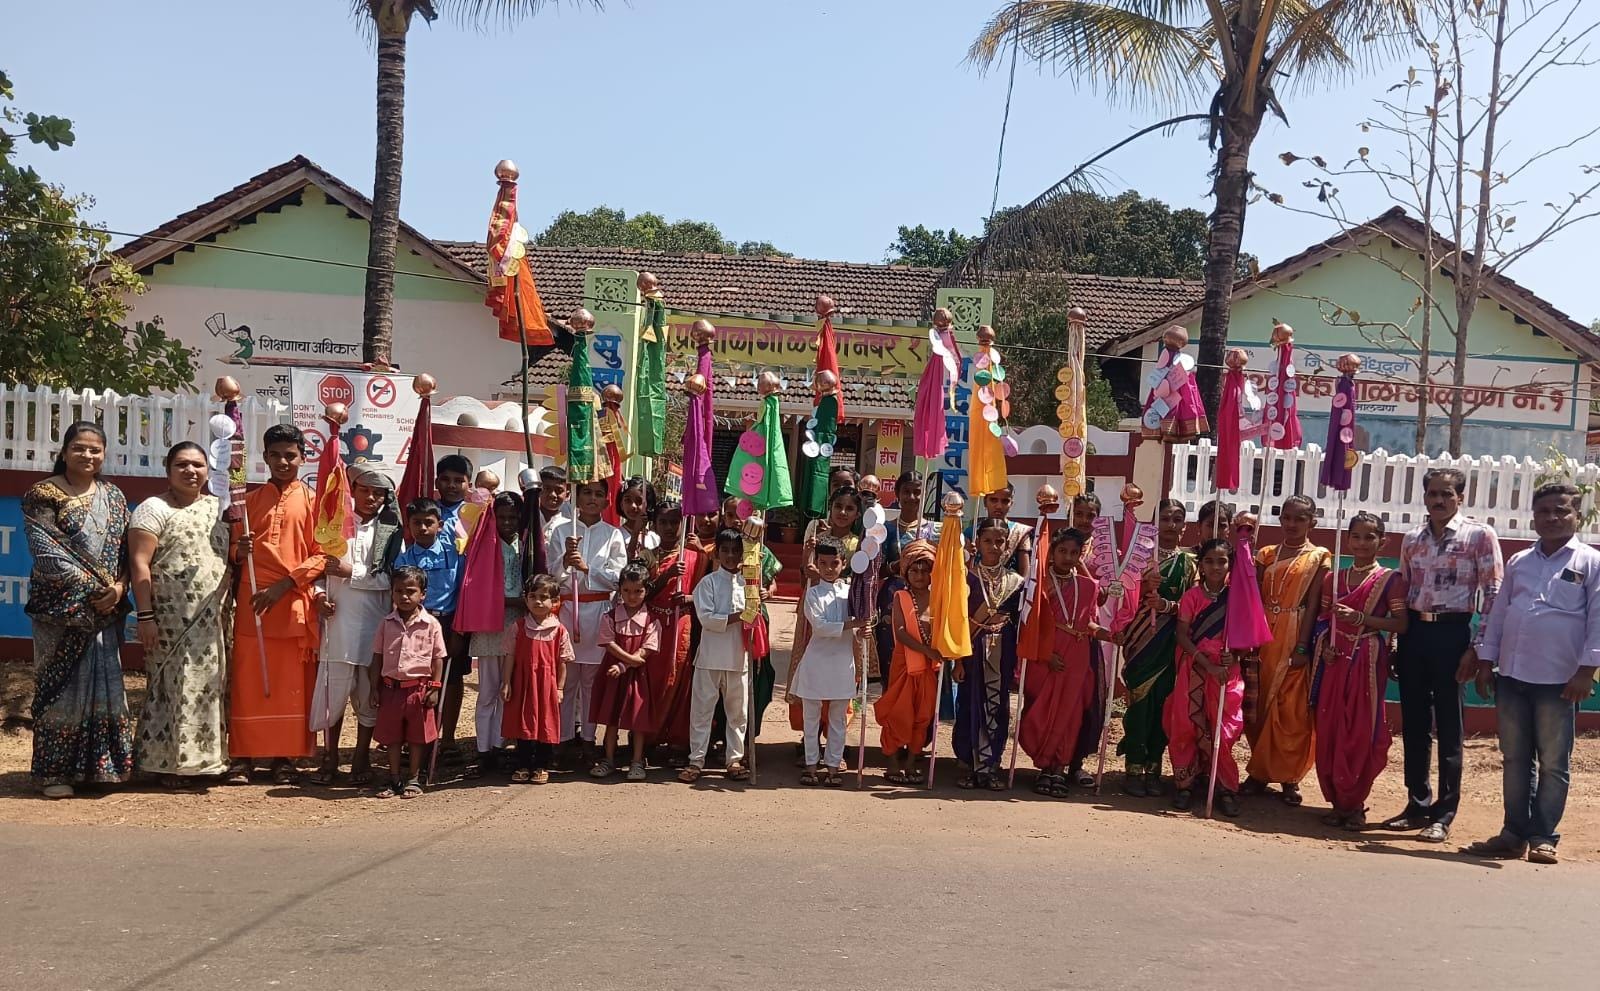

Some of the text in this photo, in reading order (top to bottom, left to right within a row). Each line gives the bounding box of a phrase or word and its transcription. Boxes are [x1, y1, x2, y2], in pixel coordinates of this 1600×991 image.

[258, 335, 360, 356] शिक्षणाचा अधिकार
[322, 387, 351, 399] STOP
[294, 420, 316, 428] DRIVE
[880, 447, 897, 466] हीच
